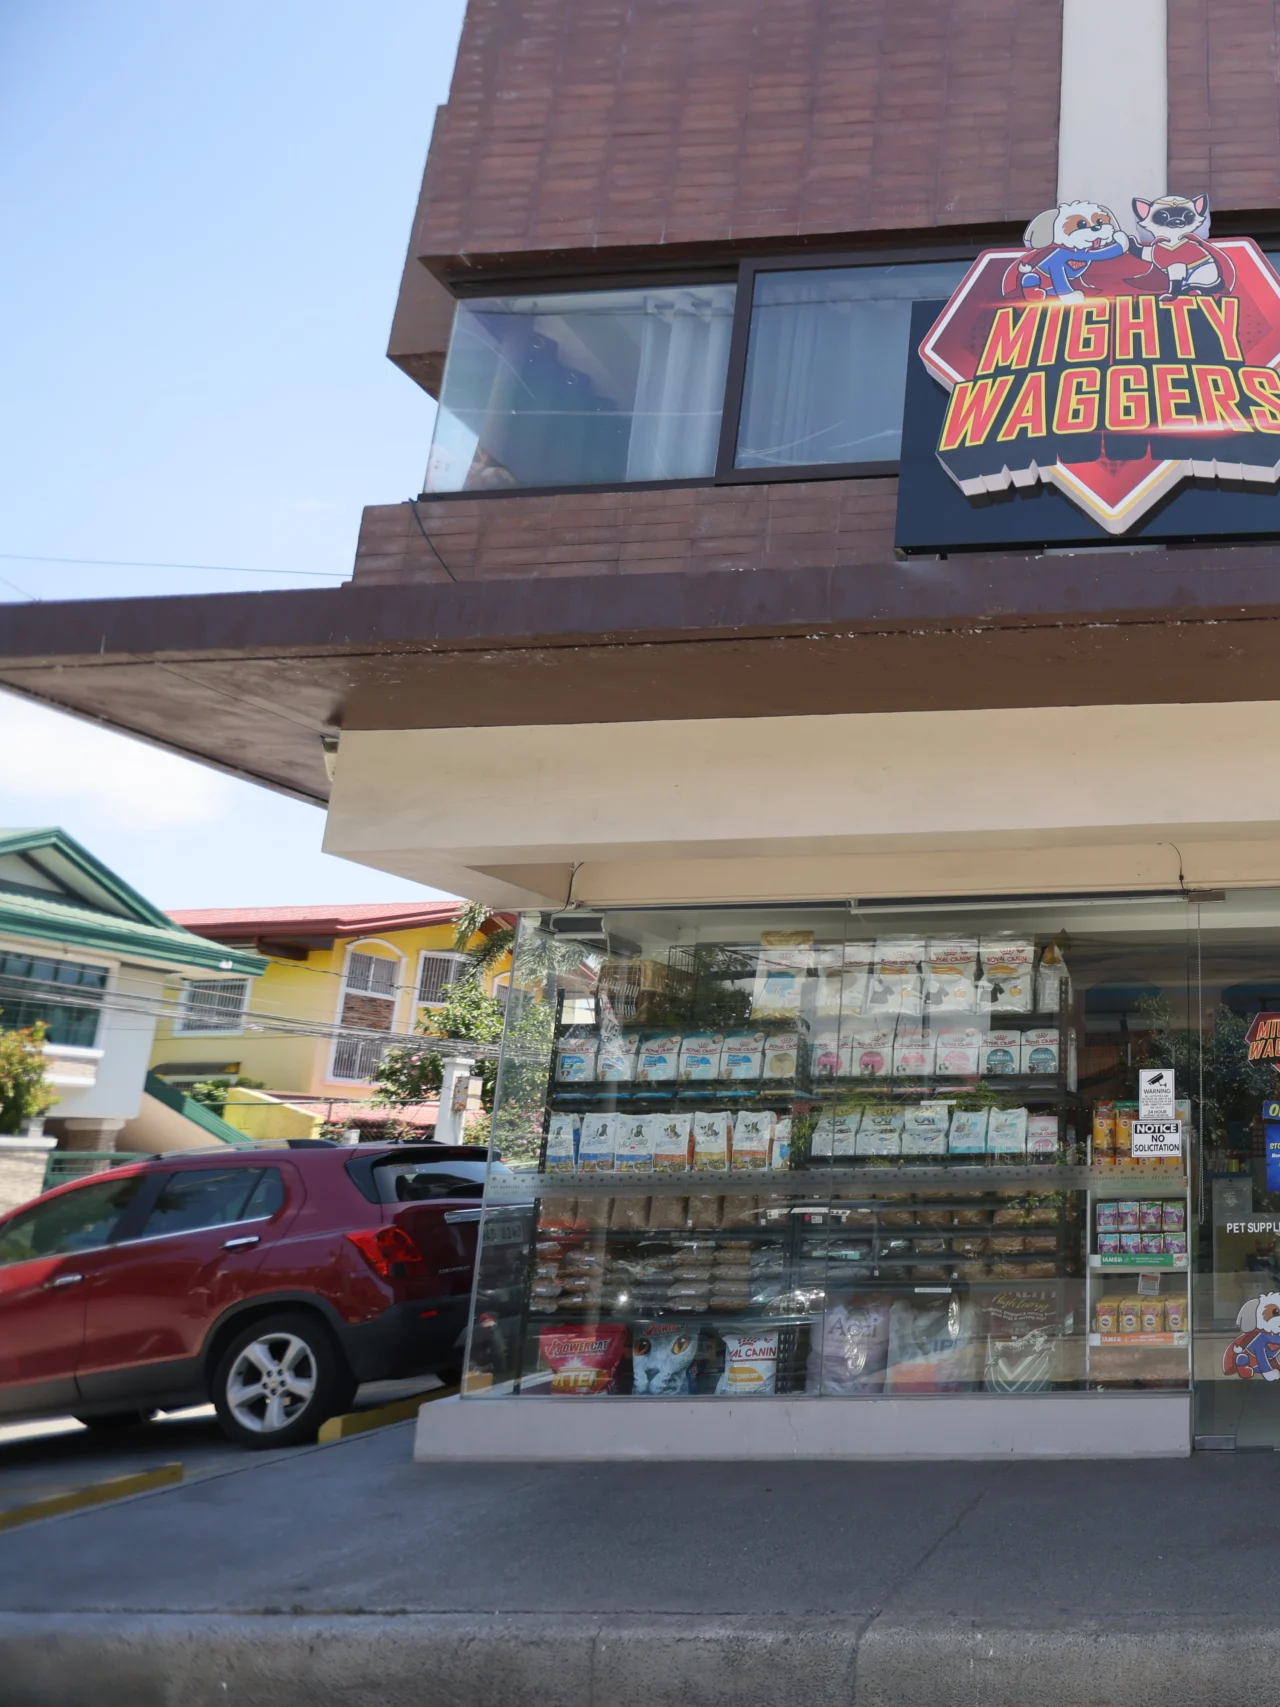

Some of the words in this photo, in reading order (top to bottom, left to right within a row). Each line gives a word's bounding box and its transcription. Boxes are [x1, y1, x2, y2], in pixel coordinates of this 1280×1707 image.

[977, 296, 1244, 377] MIGHTY
[1136, 1124, 1177, 1133] NOTICE
[1151, 1134, 1165, 1142] NO
[1134, 1144, 1179, 1152] SOLICITATION
[1226, 1223, 1245, 1234] PET
[556, 1340, 610, 1353] POWERCAT
[745, 1347, 777, 1357] CANIN
